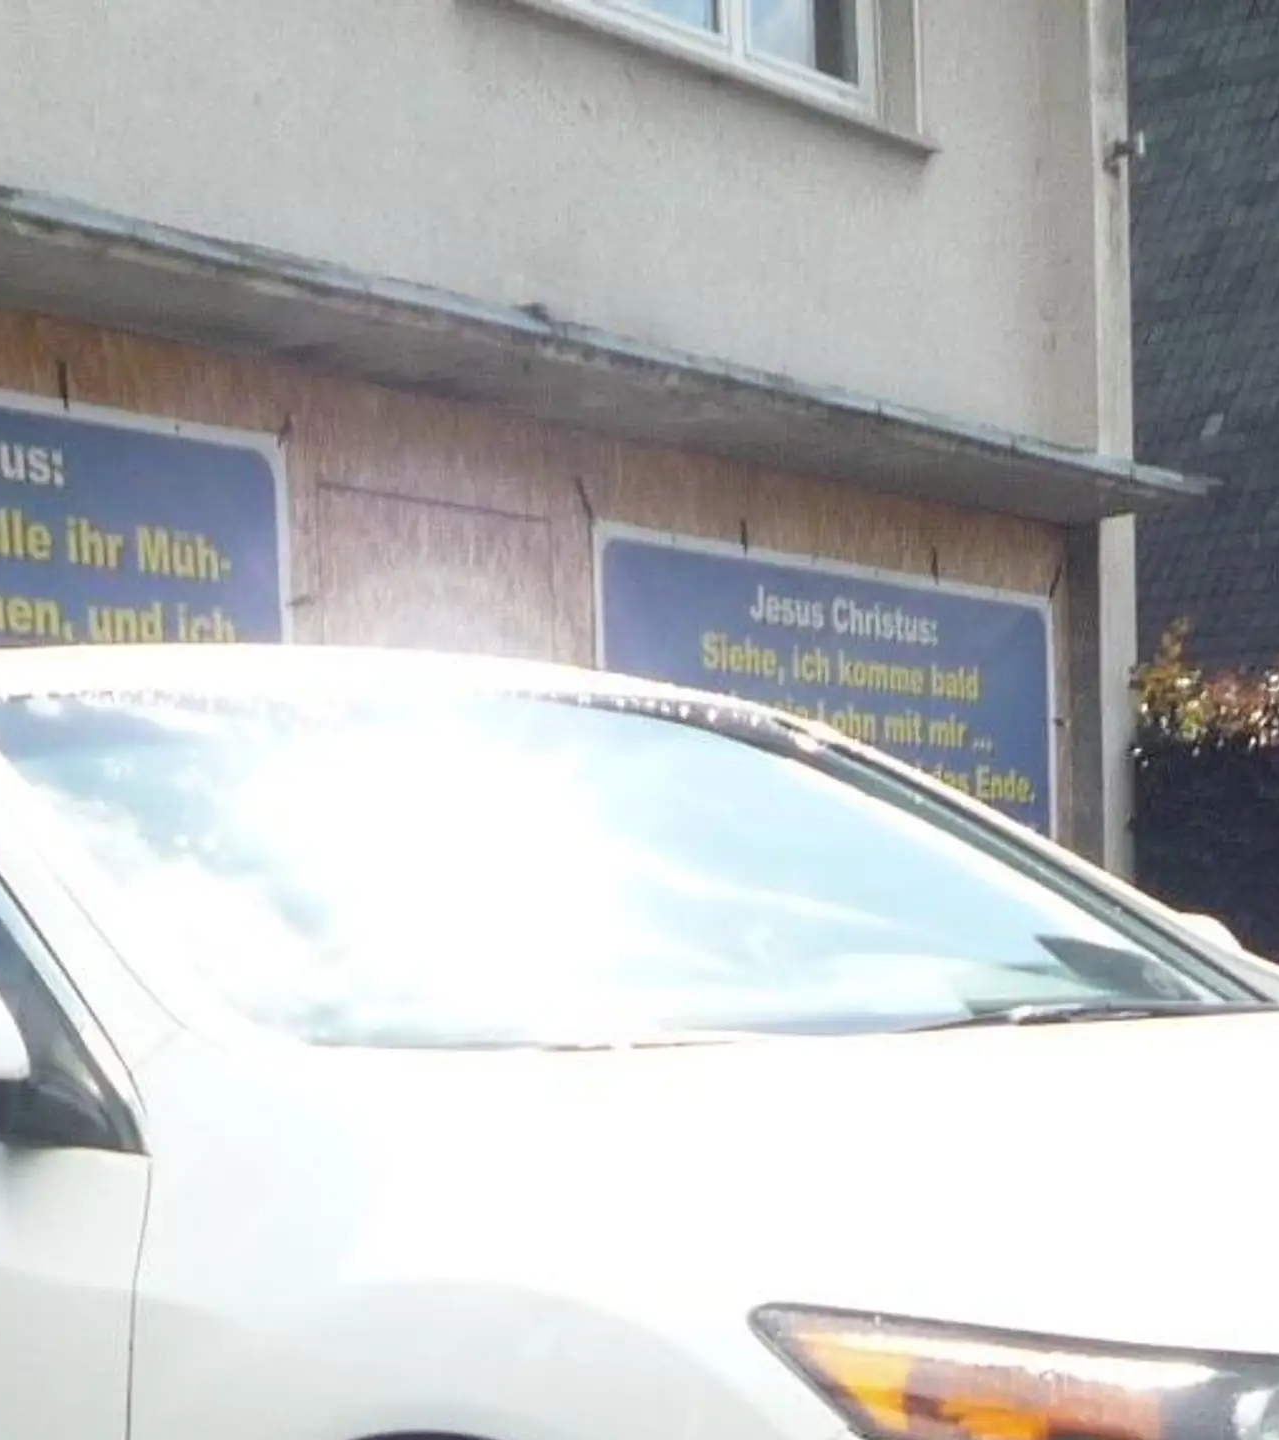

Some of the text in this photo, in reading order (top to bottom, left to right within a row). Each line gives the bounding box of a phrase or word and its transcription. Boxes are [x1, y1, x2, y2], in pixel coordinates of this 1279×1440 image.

[67, 517, 123, 569] ihr
[136, 526, 232, 581] Müh-
[88, 602, 163, 642] und
[177, 602, 237, 643] ich
[749, 585, 824, 630] Jesus
[702, 631, 978, 701] Siehe, ich komme bald
[884, 710, 921, 746] mit
[929, 714, 967, 748] mir
